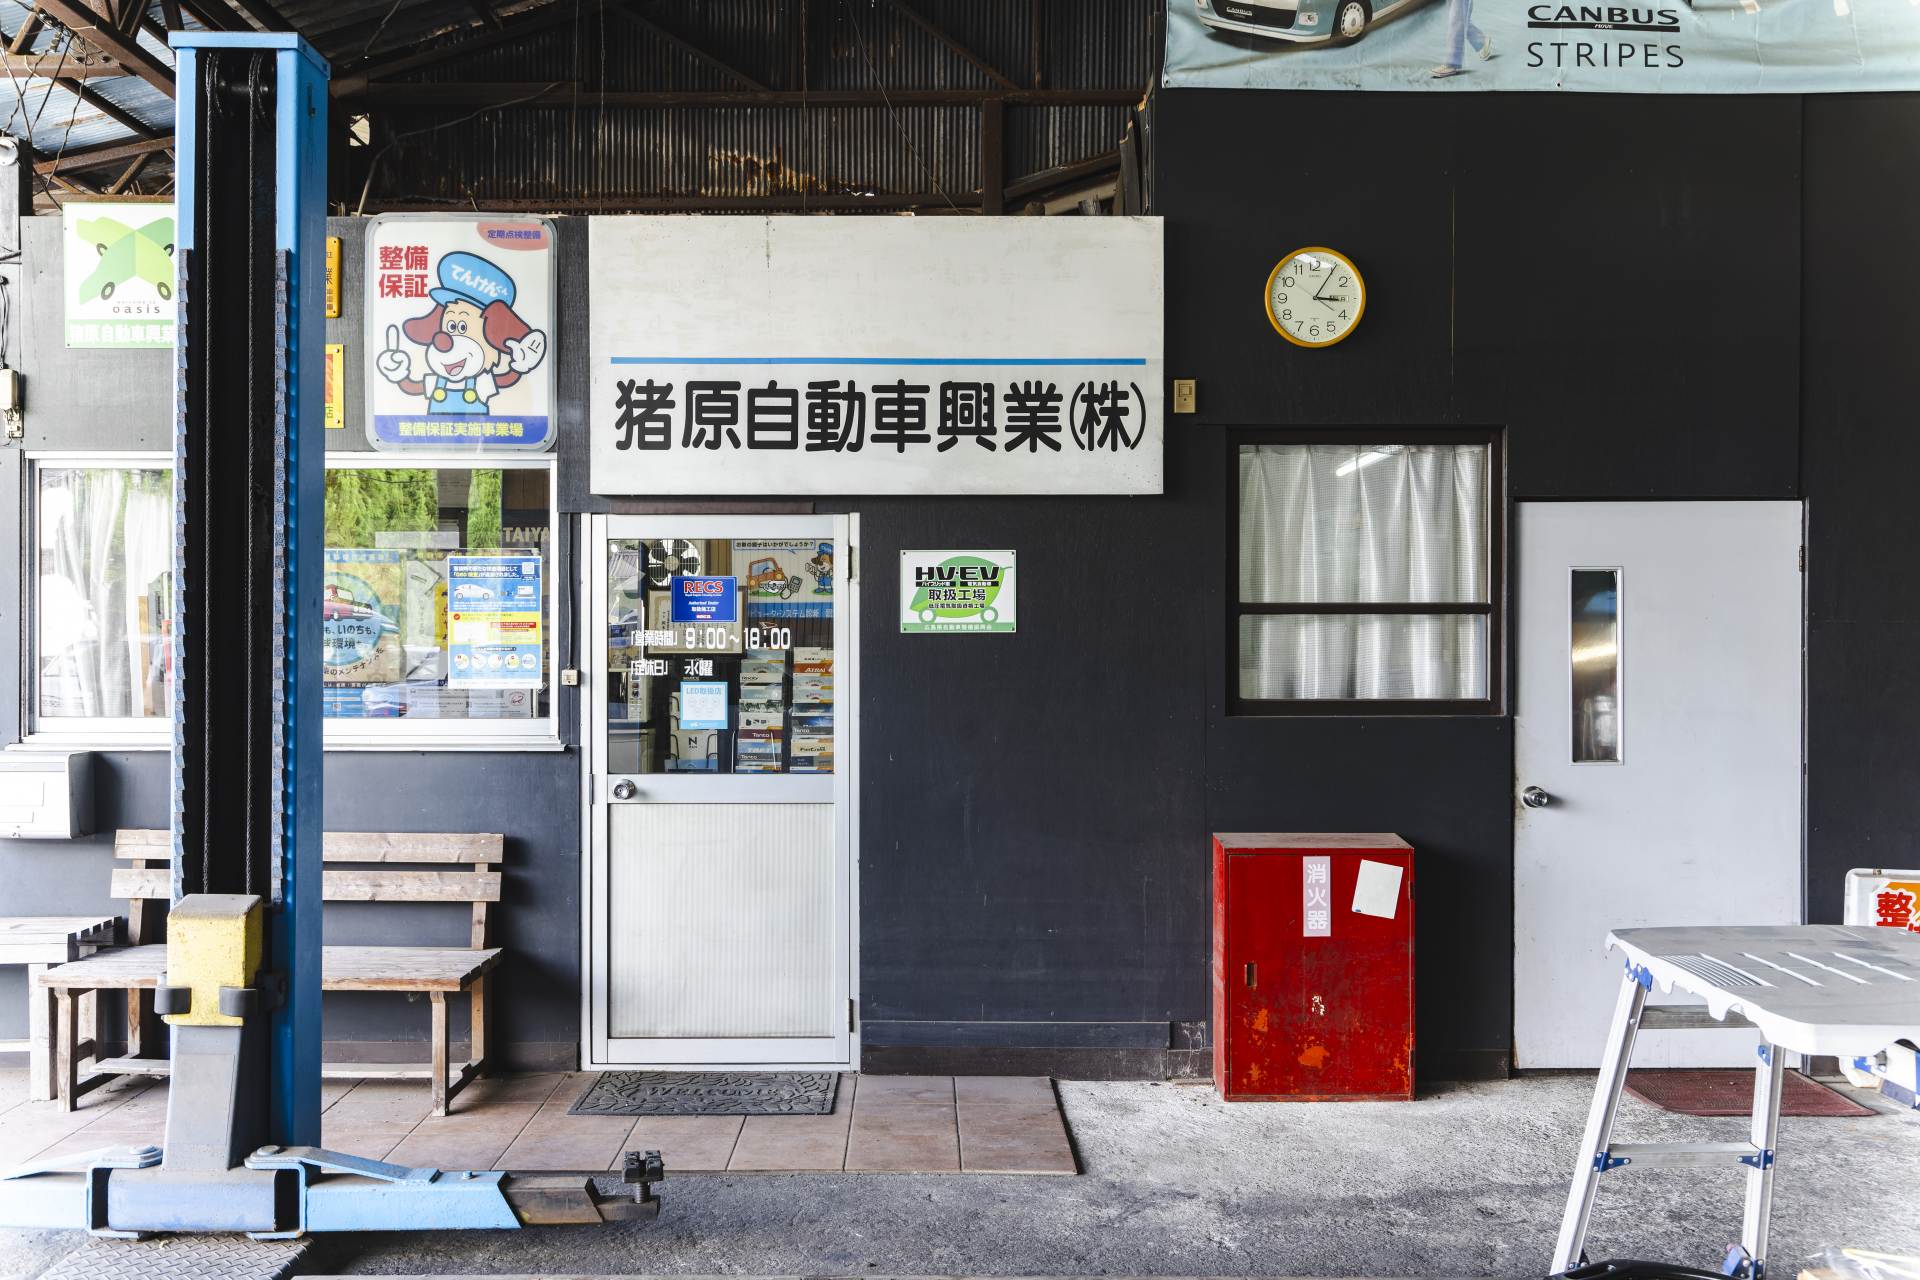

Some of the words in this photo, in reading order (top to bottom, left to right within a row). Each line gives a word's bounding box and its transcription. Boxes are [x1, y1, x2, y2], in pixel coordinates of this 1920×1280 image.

[1527, 5, 1679, 25] CANBUS
[1527, 42, 1684, 68] STRIPES
[487, 230, 541, 240] 定期点検整備
[379, 246, 429, 270] 整備
[379, 274, 429, 298] 保証
[1282, 276, 1295, 288] 10
[1339, 276, 1348, 288] 2
[1278, 292, 1288, 304] 9
[112, 304, 160, 314] oasis
[1282, 308, 1292, 321] 8
[1338, 309, 1347, 320] 4
[1296, 321, 1304, 332] 7
[1309, 325, 1320, 337] 6
[1326, 321, 1336, 332] 5
[614, 379, 1147, 452] 猪原自動車興業(株)
[398, 422, 524, 437] 整備保証実施事業場
[684, 580, 724, 594] RECS
[928, 589, 986, 601] 取扱工場
[630, 629, 678, 647] 「営業時間」
[683, 659, 714, 677] 水曜
[1307, 863, 1328, 930] 消火器
[1876, 891, 1912, 927] 整
